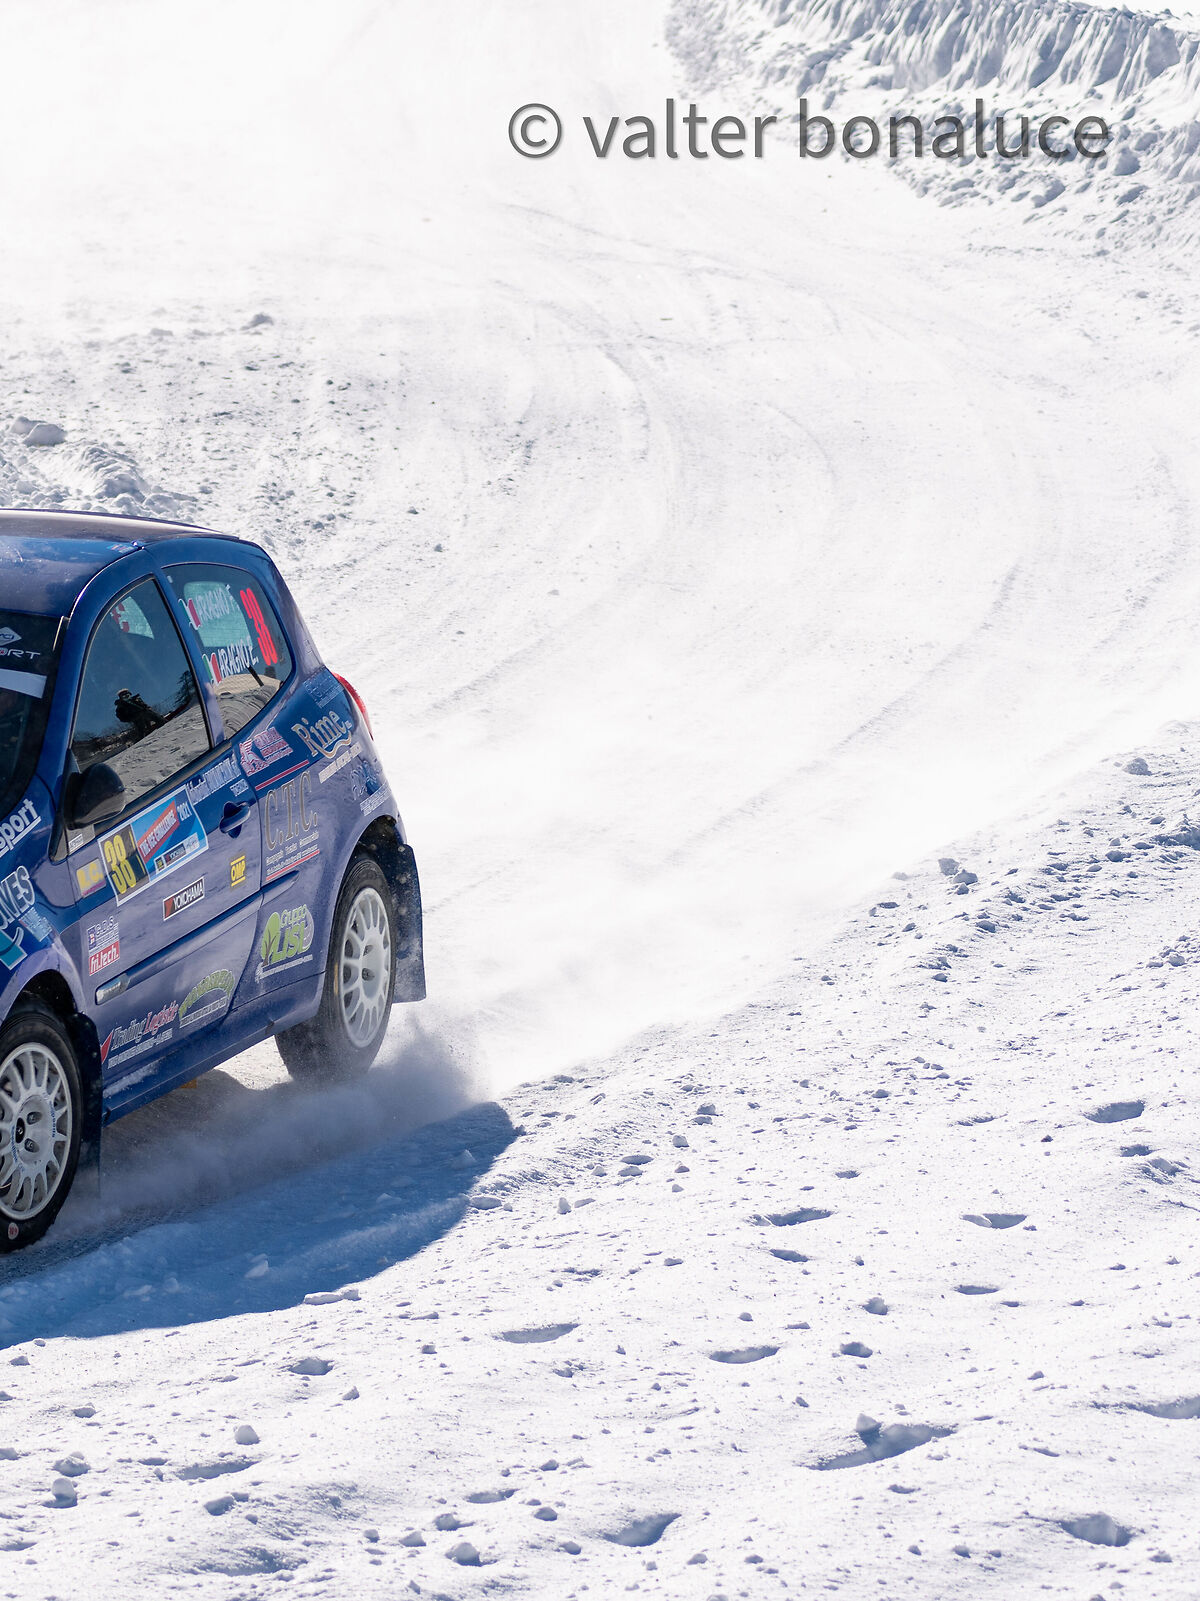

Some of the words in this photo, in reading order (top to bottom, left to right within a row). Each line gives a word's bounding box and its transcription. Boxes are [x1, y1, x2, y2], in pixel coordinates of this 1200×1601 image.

[240, 587, 278, 666] 38
[217, 637, 250, 679] ARAGNO
[177, 801, 192, 821] 2021
[265, 770, 318, 851] C.T.C.
[104, 835, 136, 894] 38
[231, 861, 246, 881] OMP
[174, 881, 204, 911] YOKOHAMA
